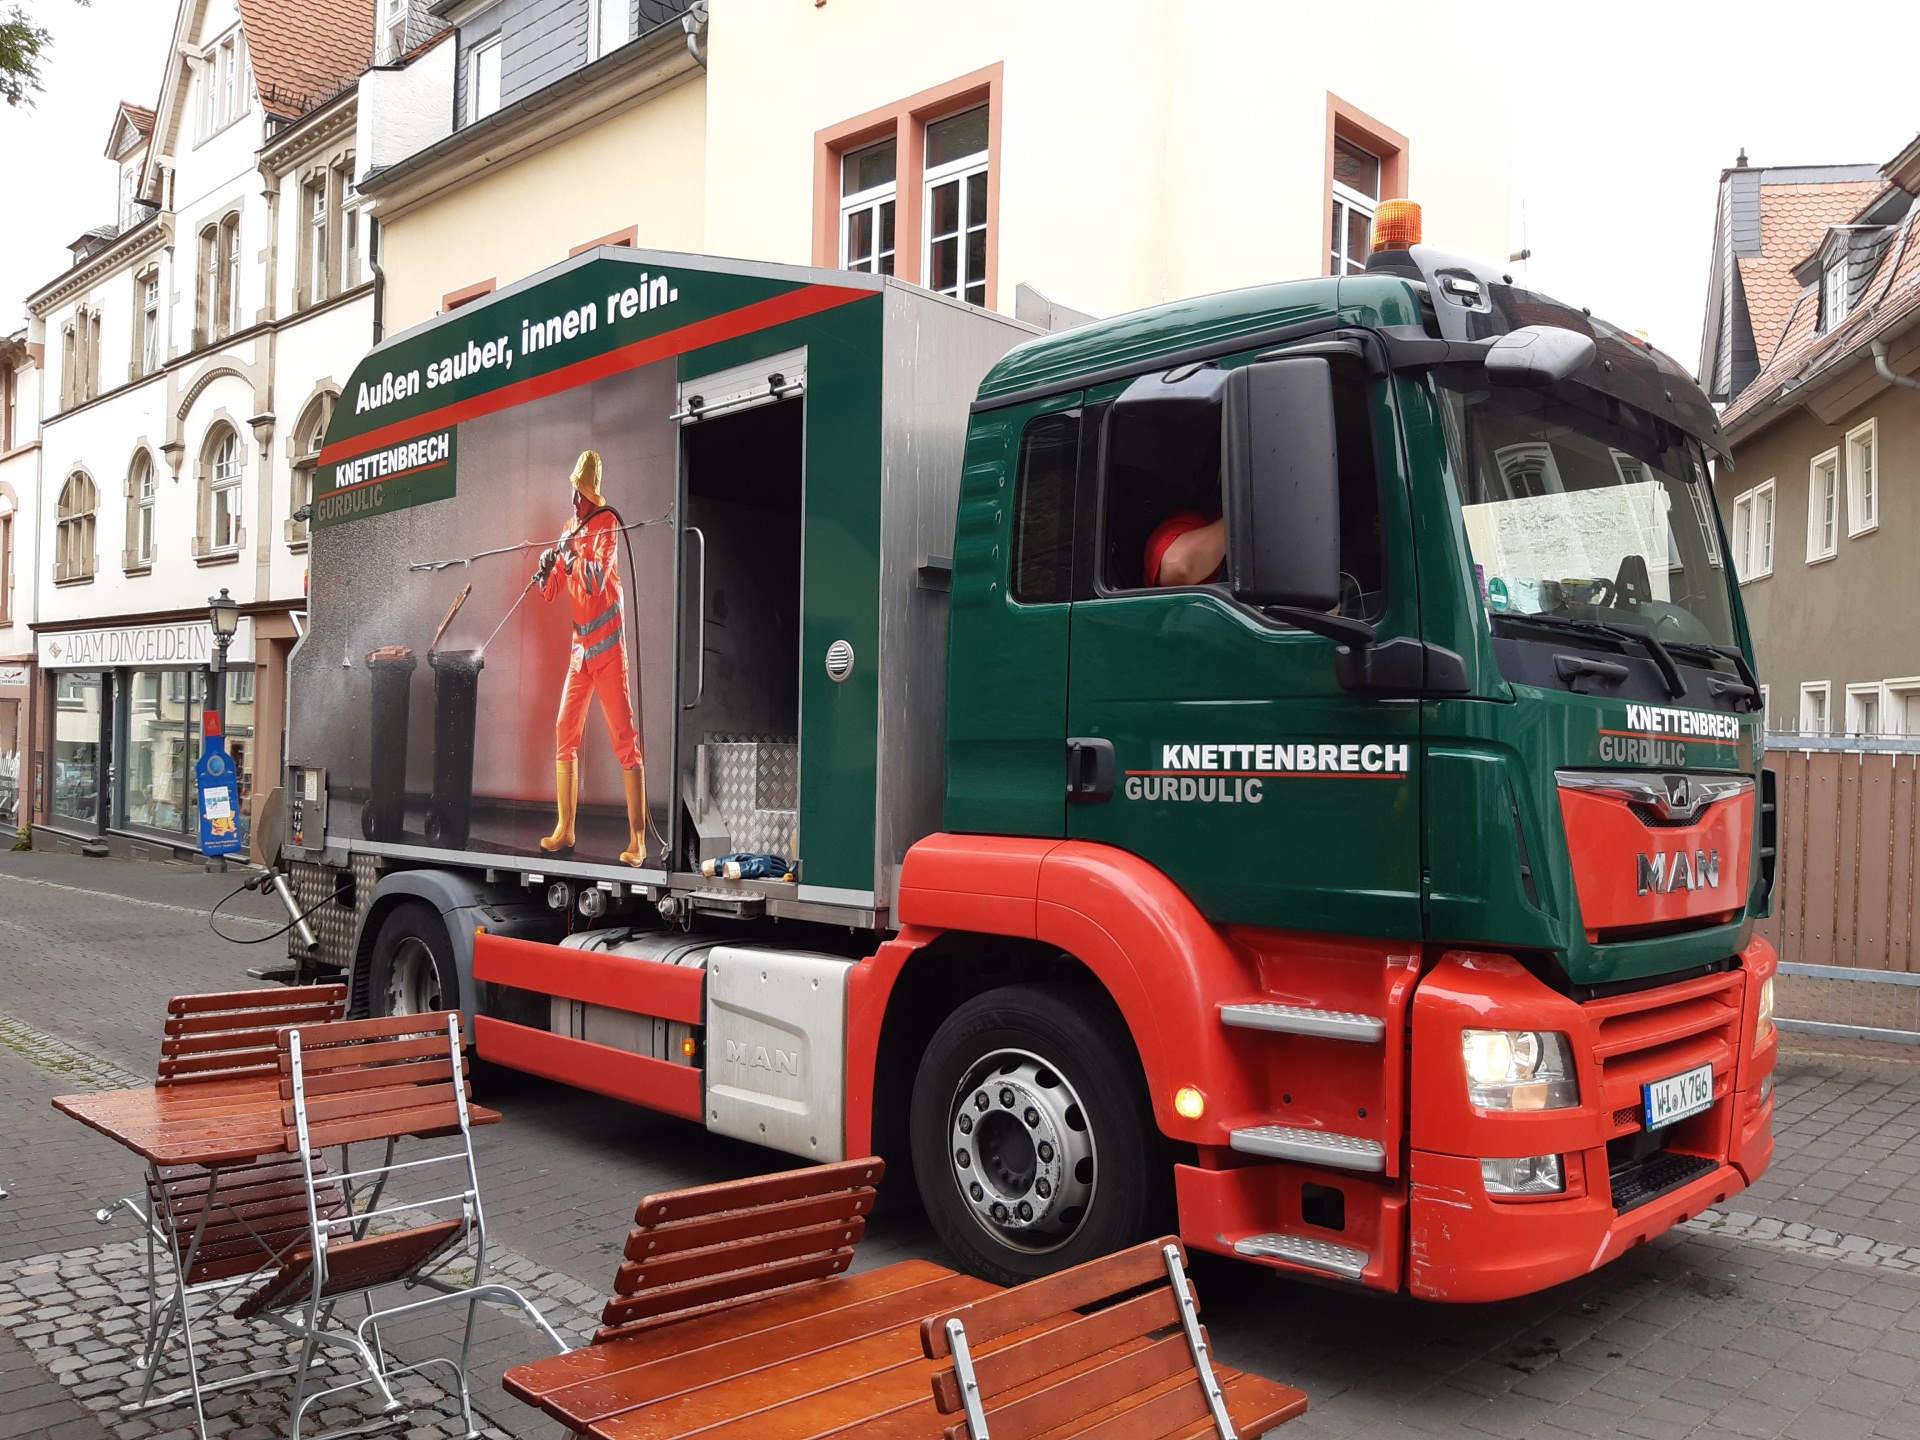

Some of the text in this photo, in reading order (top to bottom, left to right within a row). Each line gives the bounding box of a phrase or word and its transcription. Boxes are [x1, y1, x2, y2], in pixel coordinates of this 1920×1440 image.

[355, 272, 679, 415] Außen sauber, innen rein.
[335, 432, 450, 489] KNETTENBRECH
[317, 483, 384, 522] GURDULIC
[65, 625, 207, 664] ADAM DINGELDEIN
[1626, 704, 1739, 739] KNETTENBRECH
[1162, 744, 1409, 772] KNETTENBRECH
[1599, 736, 1686, 765] GURDULIC
[1125, 777, 1263, 803] GURDULIC
[1637, 849, 1720, 896] MAN
[726, 1039, 798, 1077] MAN
[1688, 1071, 1708, 1104] 786
